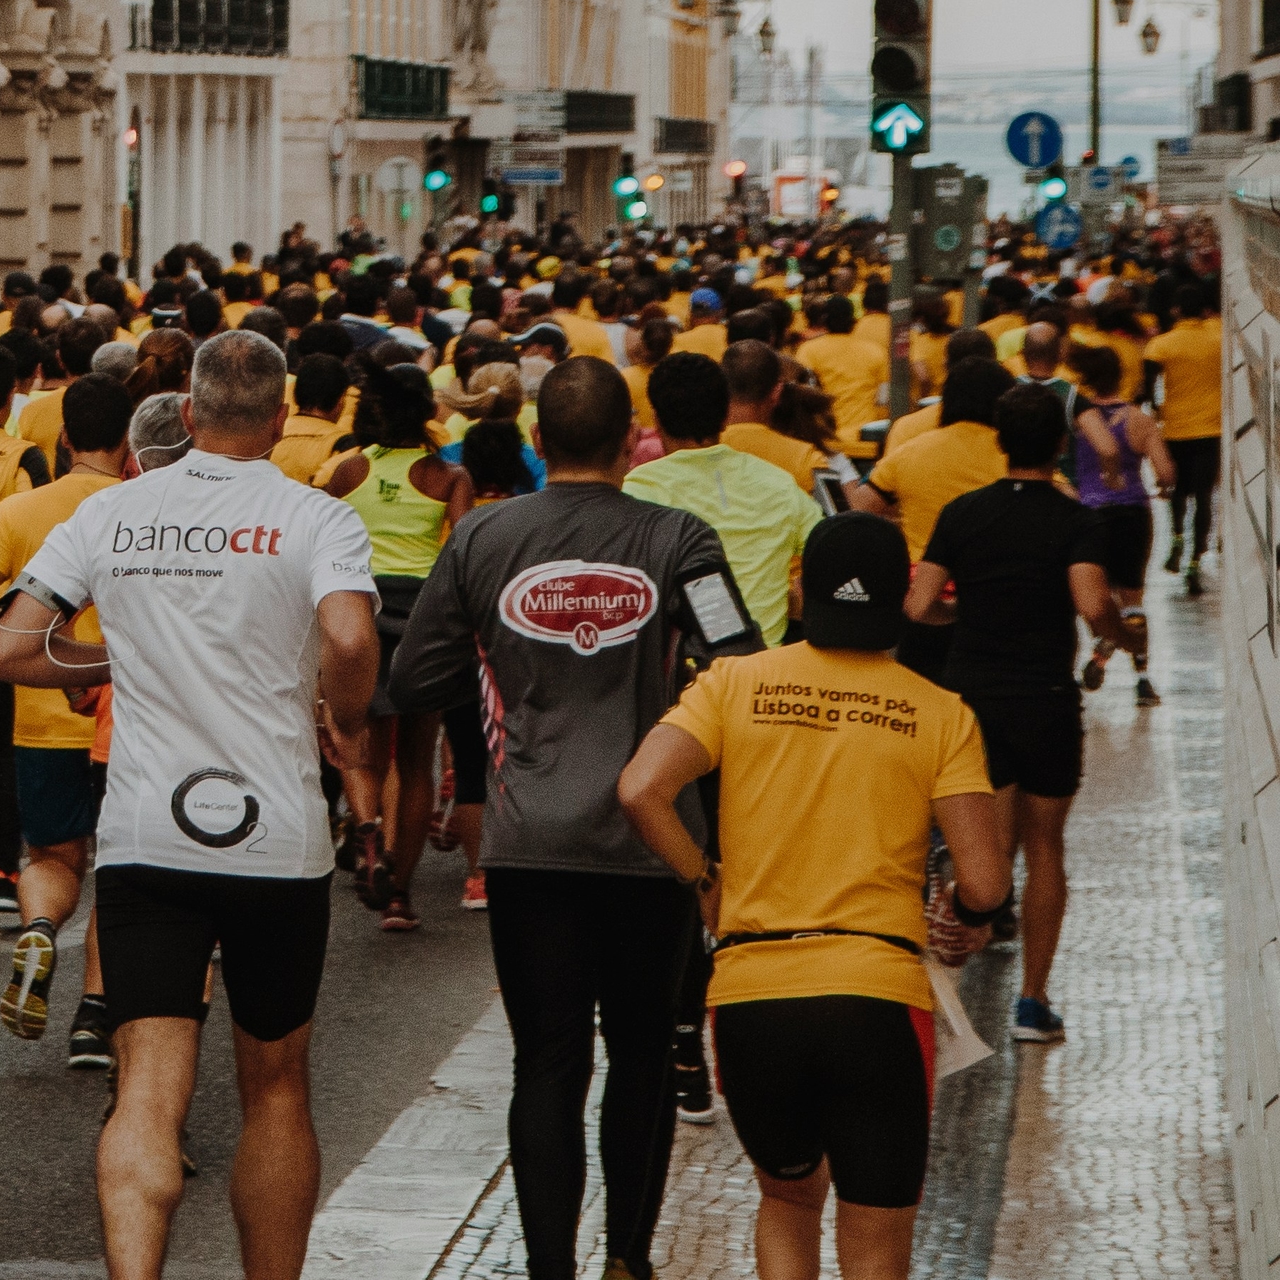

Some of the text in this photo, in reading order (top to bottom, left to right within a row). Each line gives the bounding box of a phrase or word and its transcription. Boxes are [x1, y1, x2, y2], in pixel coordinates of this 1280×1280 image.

[121, 566, 150, 577] banco
[152, 568, 172, 578] que
[174, 569, 194, 577] nos
[195, 569, 224, 578] move
[538, 579, 575, 592] clube
[524, 592, 639, 612] Millennium
[833, 591, 871, 602] adidas
[579, 629, 597, 647] M
[754, 682, 812, 697] Juntos
[817, 687, 880, 706] vamos
[753, 699, 918, 738] Lisboa a correr!
